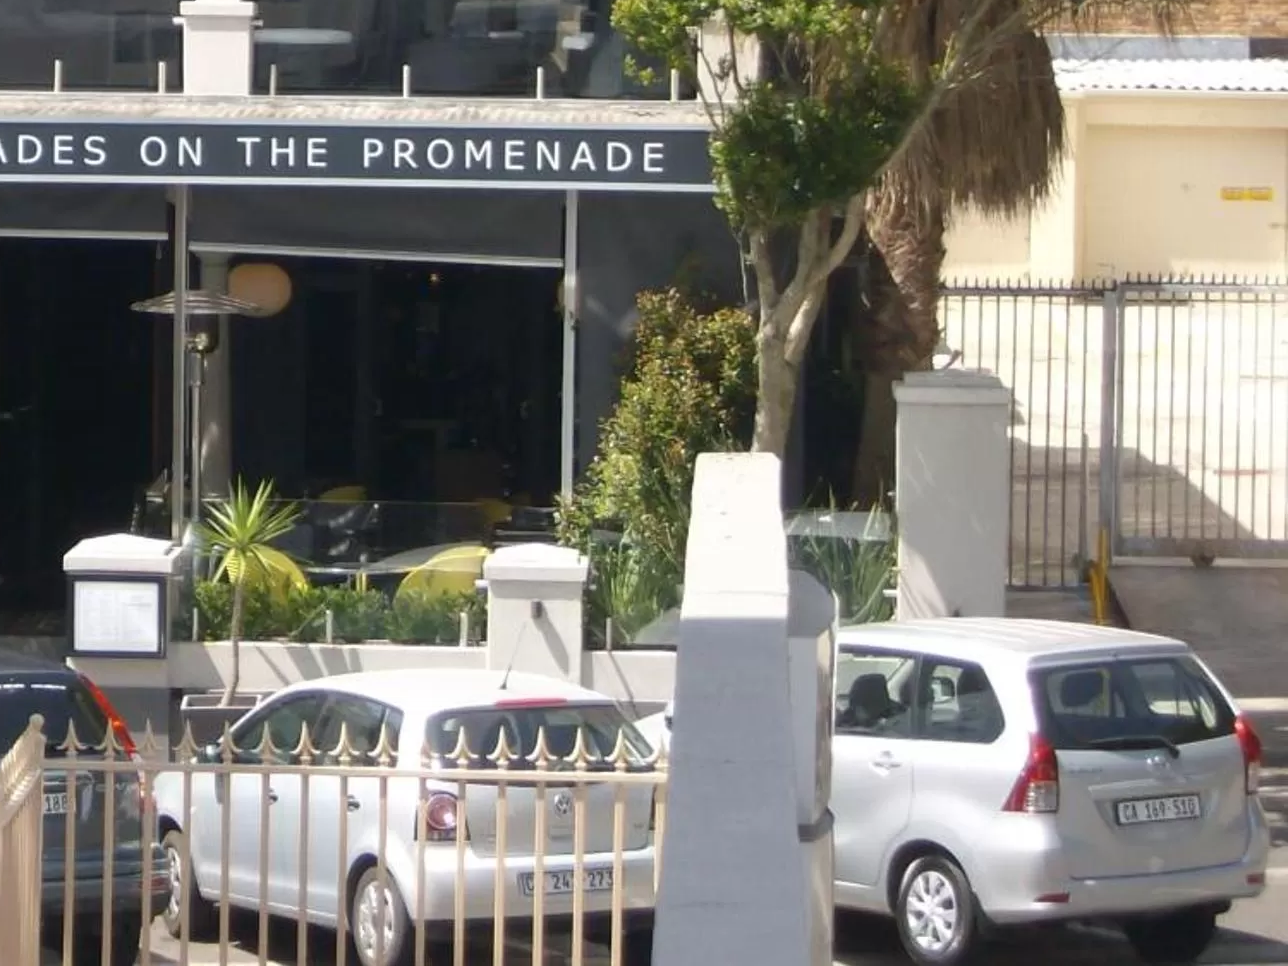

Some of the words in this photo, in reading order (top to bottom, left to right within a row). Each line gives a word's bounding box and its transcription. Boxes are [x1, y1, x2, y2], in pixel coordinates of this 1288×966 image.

[139, 135, 203, 167] ON
[236, 137, 328, 168] THE
[363, 138, 666, 173] PROMENADE
